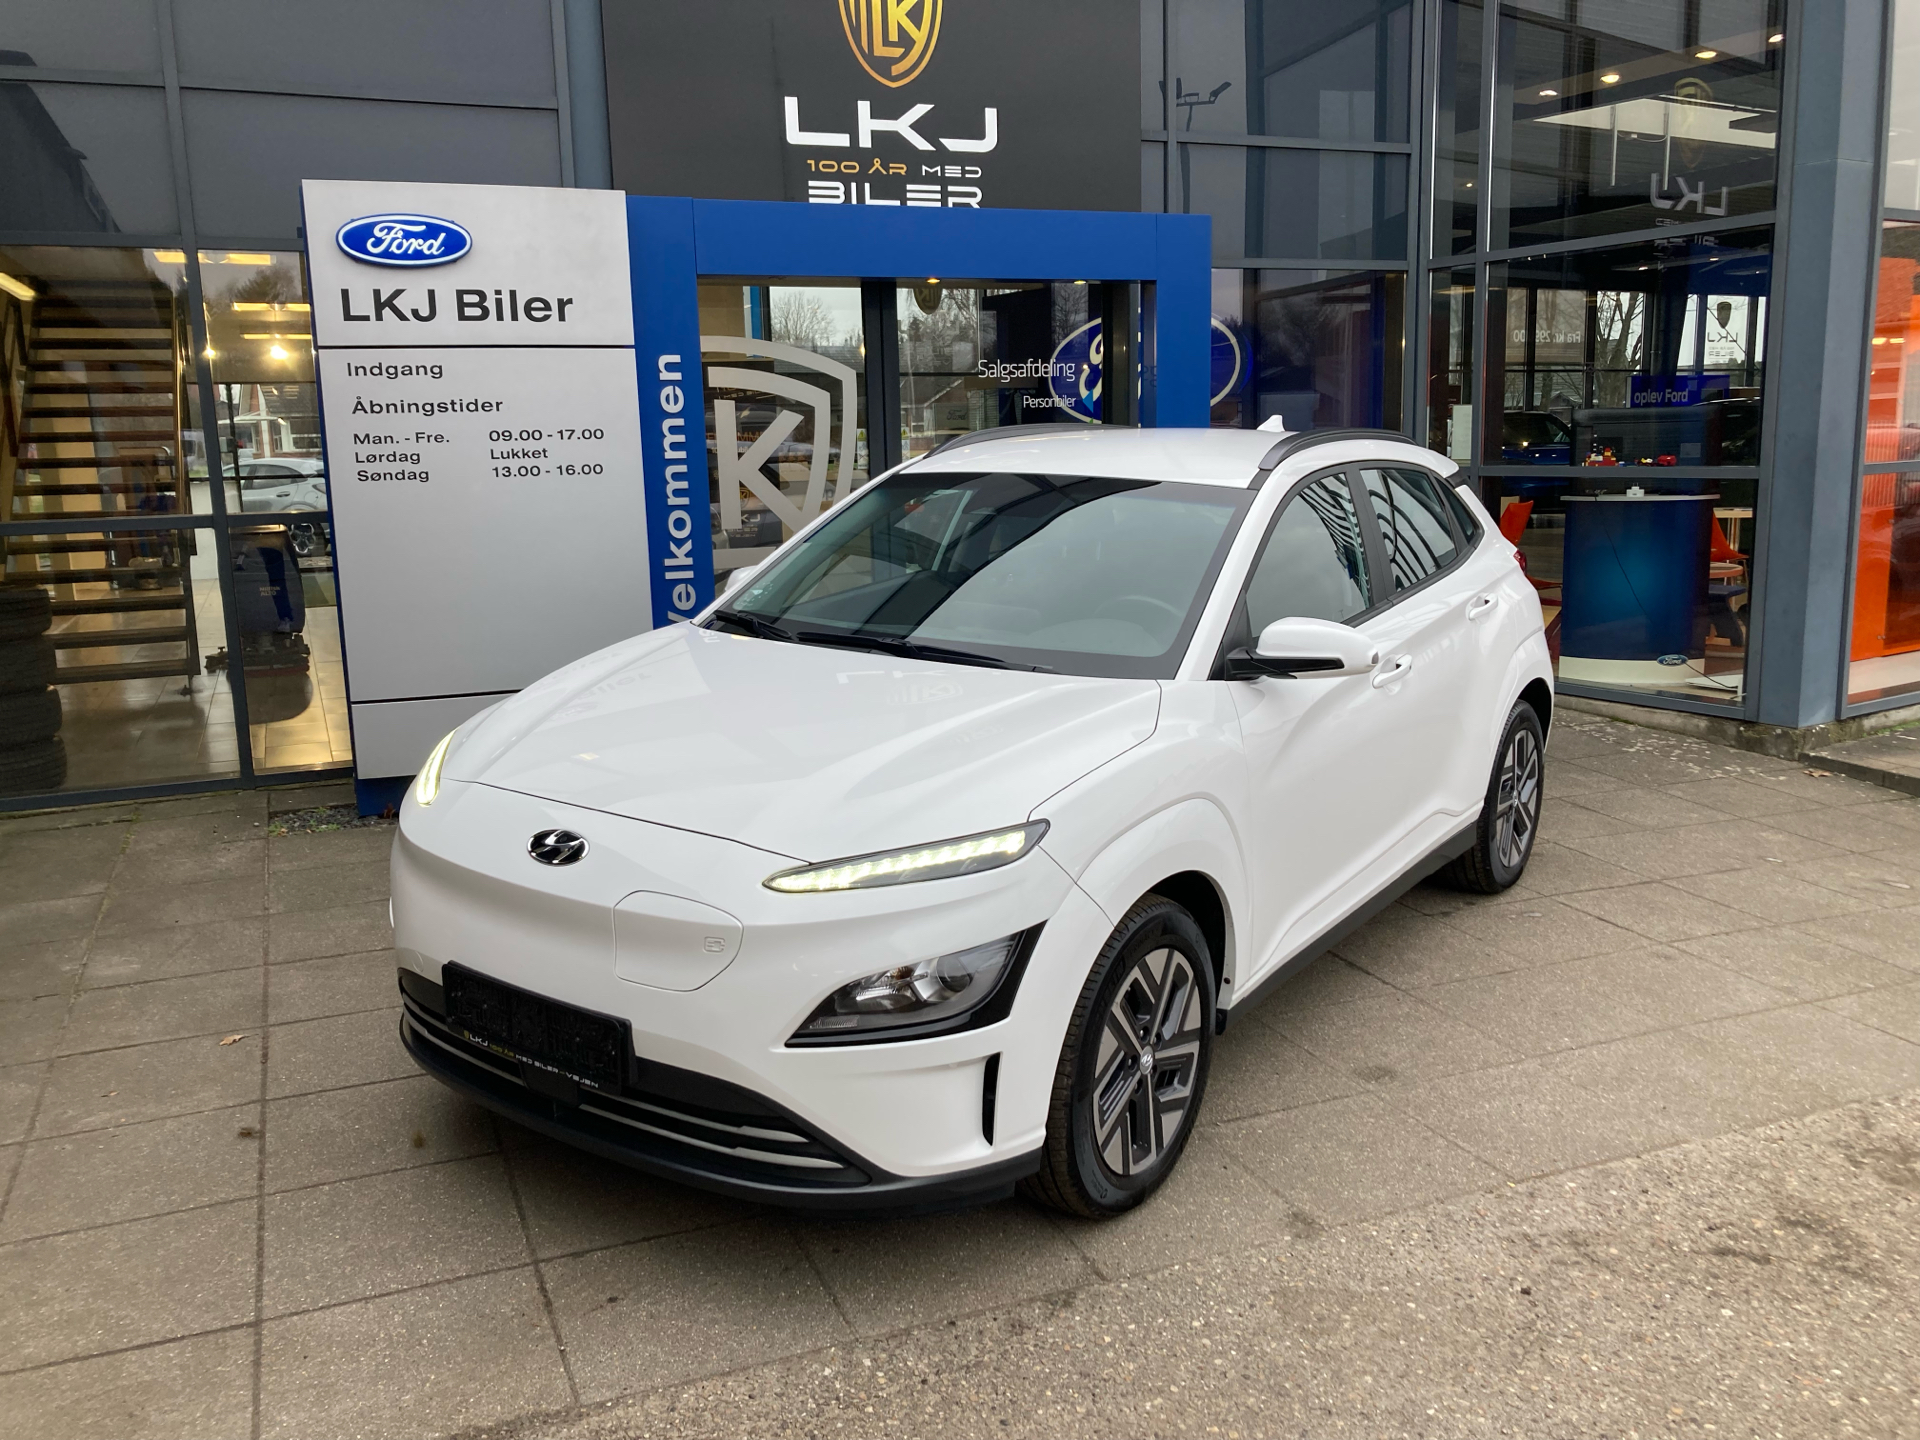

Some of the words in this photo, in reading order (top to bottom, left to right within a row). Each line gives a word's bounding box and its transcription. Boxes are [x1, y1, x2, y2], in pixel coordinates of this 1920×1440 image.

[785, 96, 998, 153] LKJ
[807, 159, 860, 174] 100
[868, 158, 907, 175] ÅR
[922, 164, 982, 178] MED
[808, 180, 983, 208] BILER
[366, 222, 446, 256] Ford
[341, 288, 438, 323] LKJ
[455, 288, 574, 322] Biler
[347, 361, 444, 380] Indgang
[978, 358, 1076, 382] Salgsafdeling
[352, 396, 503, 416] Åbningstider
[1023, 395, 1076, 409] Personbiler
[1634, 389, 1662, 405] oplev
[1665, 389, 1688, 402] Ford
[353, 432, 400, 446] Man.
[415, 431, 450, 445] Fre.
[488, 429, 543, 442] 09.00
[557, 428, 604, 441] 17.00
[355, 451, 421, 465] Lørdag
[490, 448, 549, 460] Lukket
[356, 468, 430, 483] Søndag
[492, 465, 541, 478] 13.00
[556, 463, 604, 476] 16.00
[469, 1033, 489, 1047] LKJ
[534, 1061, 559, 1073] BILER
[565, 1072, 598, 1088] VEJEN
